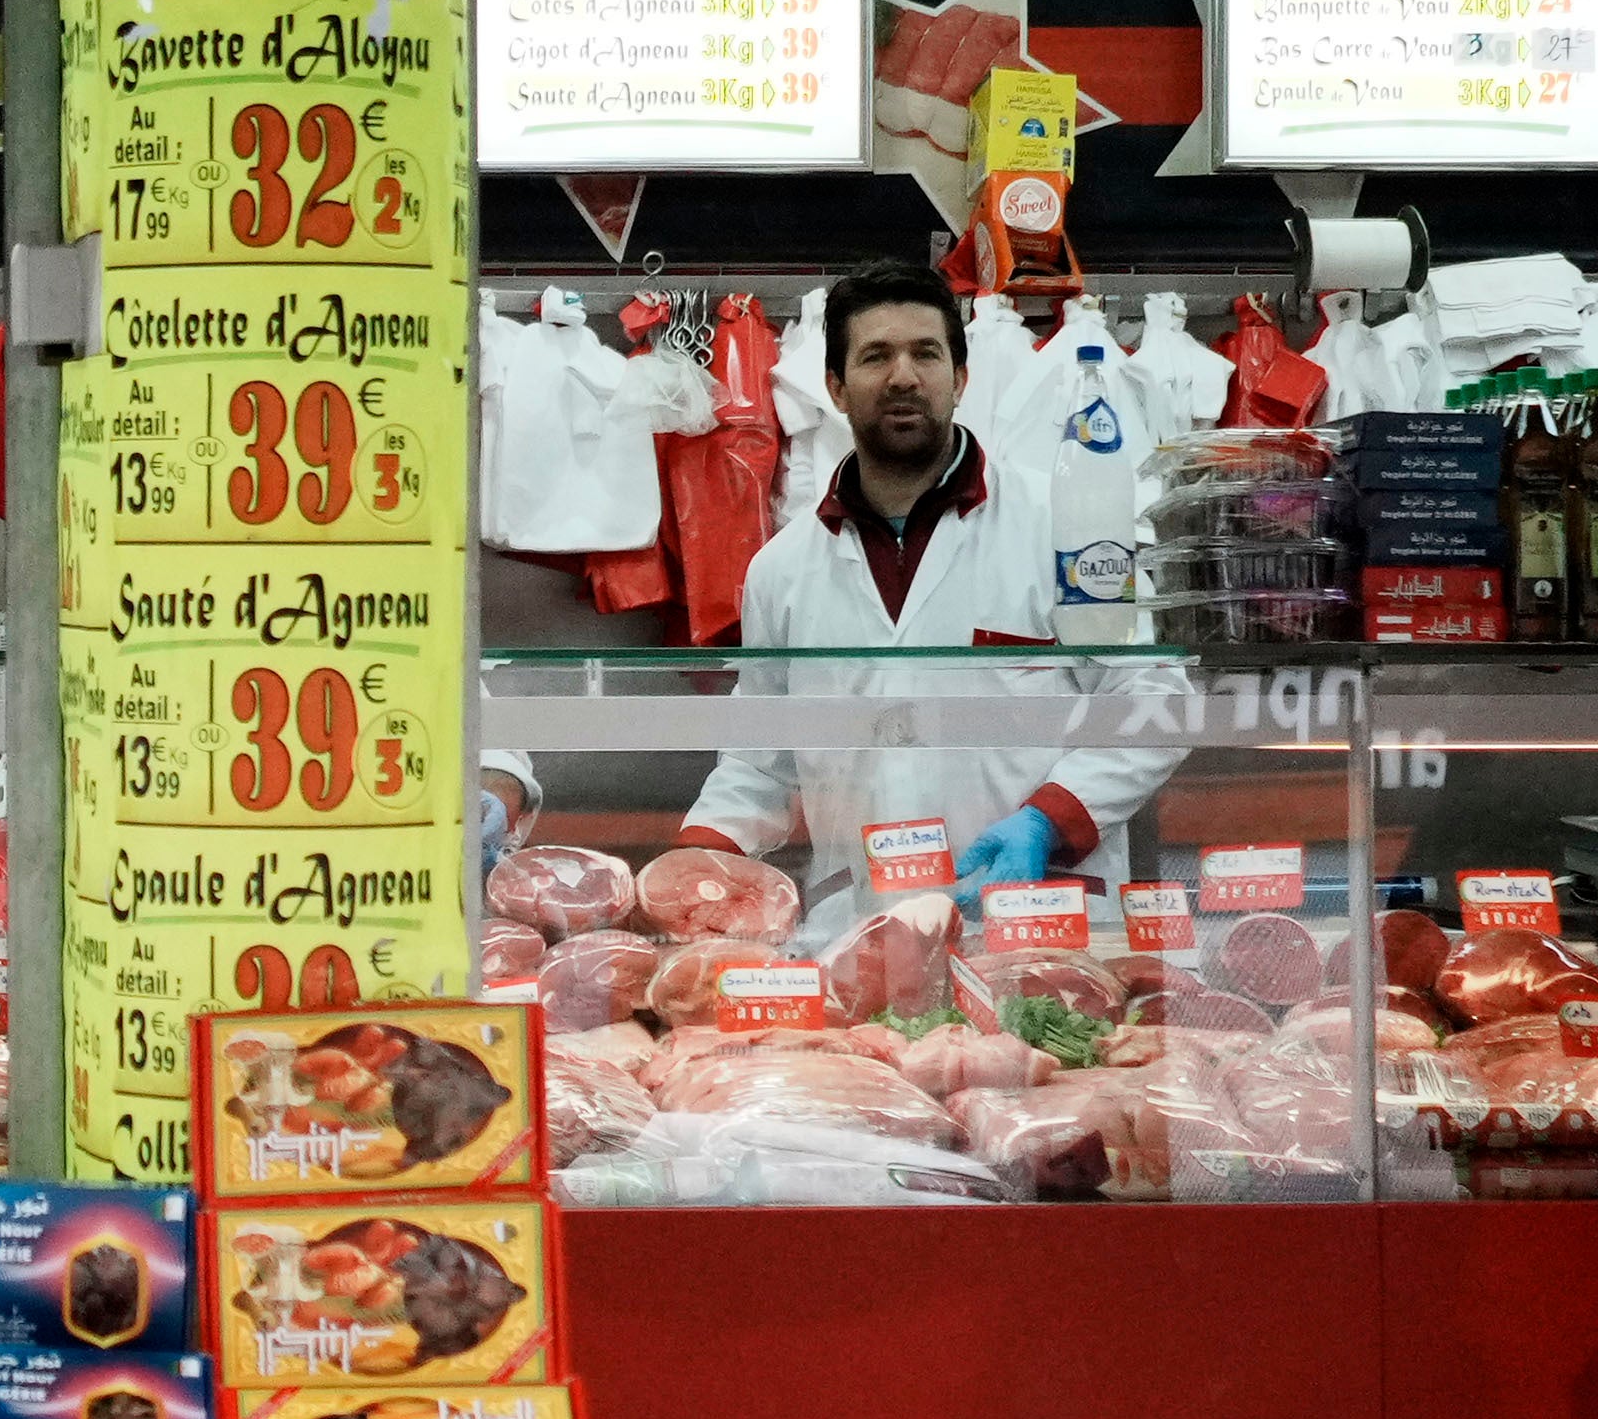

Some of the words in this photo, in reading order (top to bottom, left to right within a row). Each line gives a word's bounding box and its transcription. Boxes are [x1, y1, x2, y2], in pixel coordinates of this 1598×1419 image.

[108, 21, 244, 93] Bavette
[262, 14, 430, 84] d'Aloyau
[130, 107, 156, 129] Au
[115, 135, 168, 162] détail
[197, 165, 221, 181] OU
[385, 155, 407, 175] les
[110, 178, 145, 241] 17
[147, 212, 169, 238] 99
[1006, 196, 1052, 214] Sweet
[106, 297, 247, 369] Côtelette
[266, 293, 430, 366] d'Agneau
[129, 380, 154, 403] Au
[112, 410, 167, 436] détail
[195, 441, 218, 457] OU
[384, 431, 405, 450] les
[110, 452, 147, 514] 13
[151, 487, 175, 514] 99
[110, 572, 215, 642] Sauté
[234, 572, 430, 649] d'Agneau
[130, 664, 156, 687] Au
[114, 695, 168, 721] détail
[198, 728, 220, 744] OU
[385, 715, 408, 735] les
[115, 735, 151, 798] 13
[155, 772, 180, 798] 99
[109, 848, 224, 924] Epaule
[244, 852, 432, 928] d'Agneau
[131, 938, 154, 962] Au
[116, 970, 168, 995] détail
[114, 1008, 147, 1071] 13
[153, 1045, 175, 1073] 99
